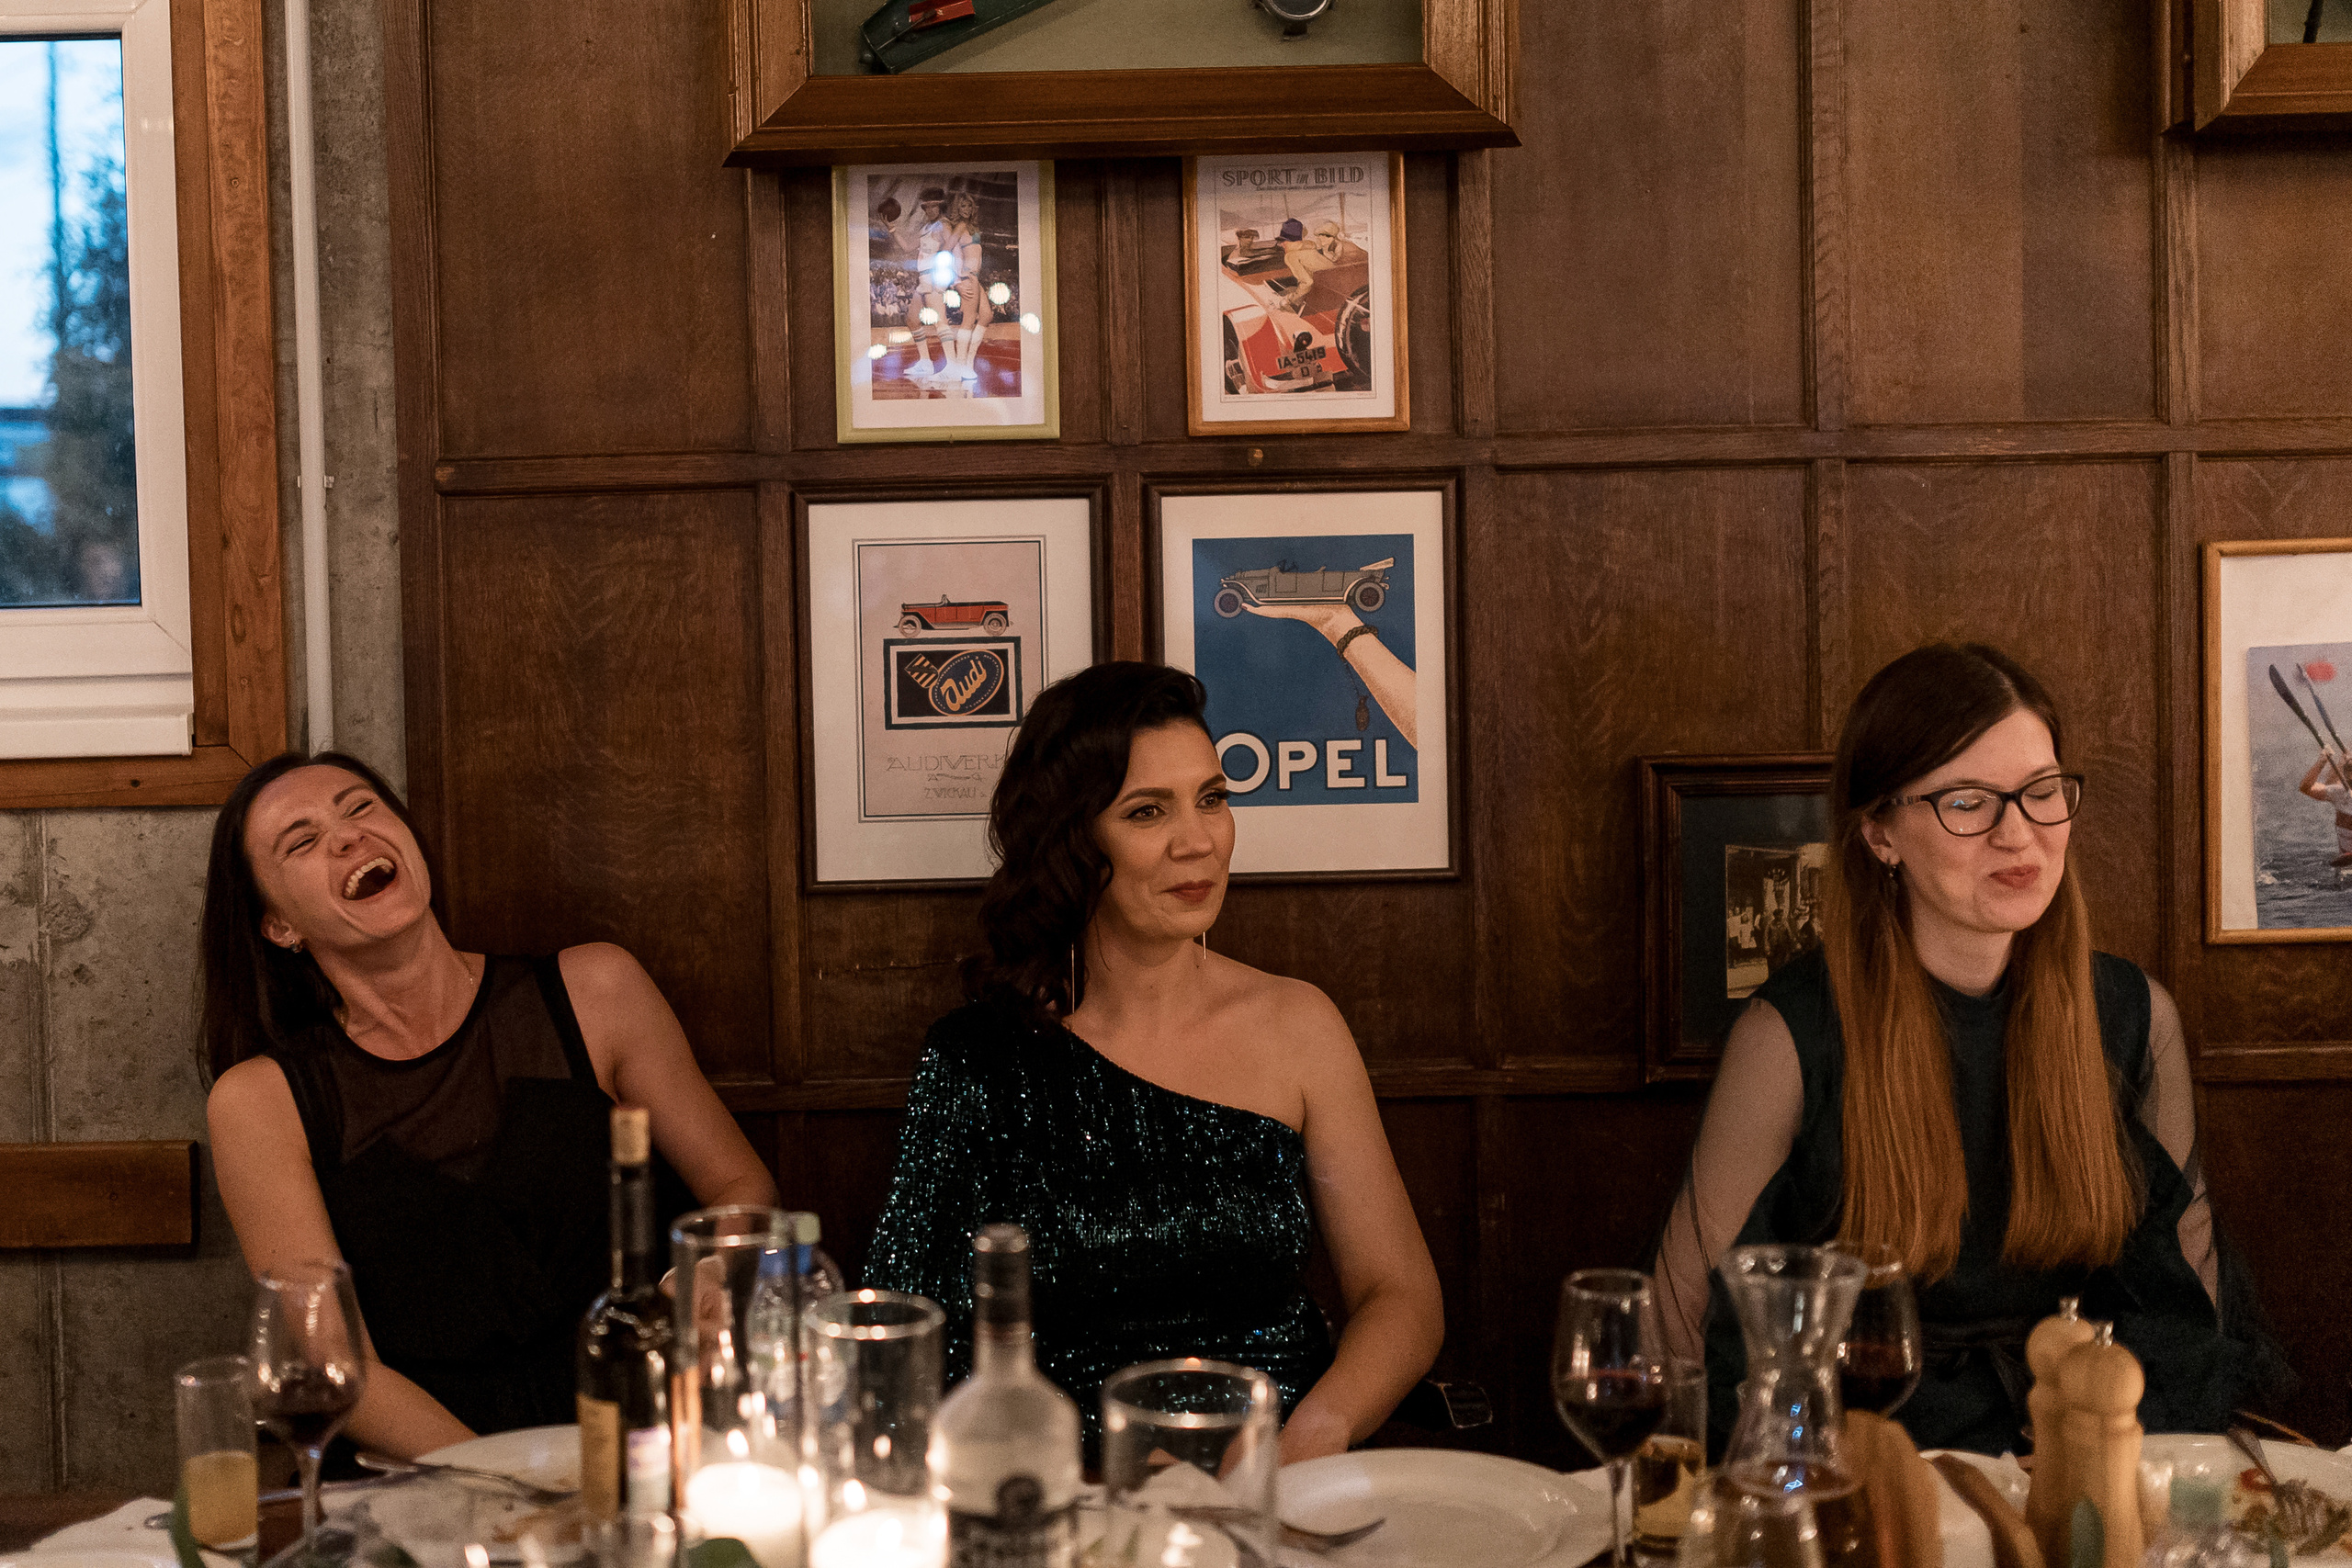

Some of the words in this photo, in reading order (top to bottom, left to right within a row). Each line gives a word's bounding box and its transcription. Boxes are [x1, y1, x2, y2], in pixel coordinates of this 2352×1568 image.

[1222, 167, 1297, 187] SPORT
[1314, 165, 1364, 185] BILD
[940, 656, 987, 712] Audi
[1215, 732, 1408, 794] OPEL
